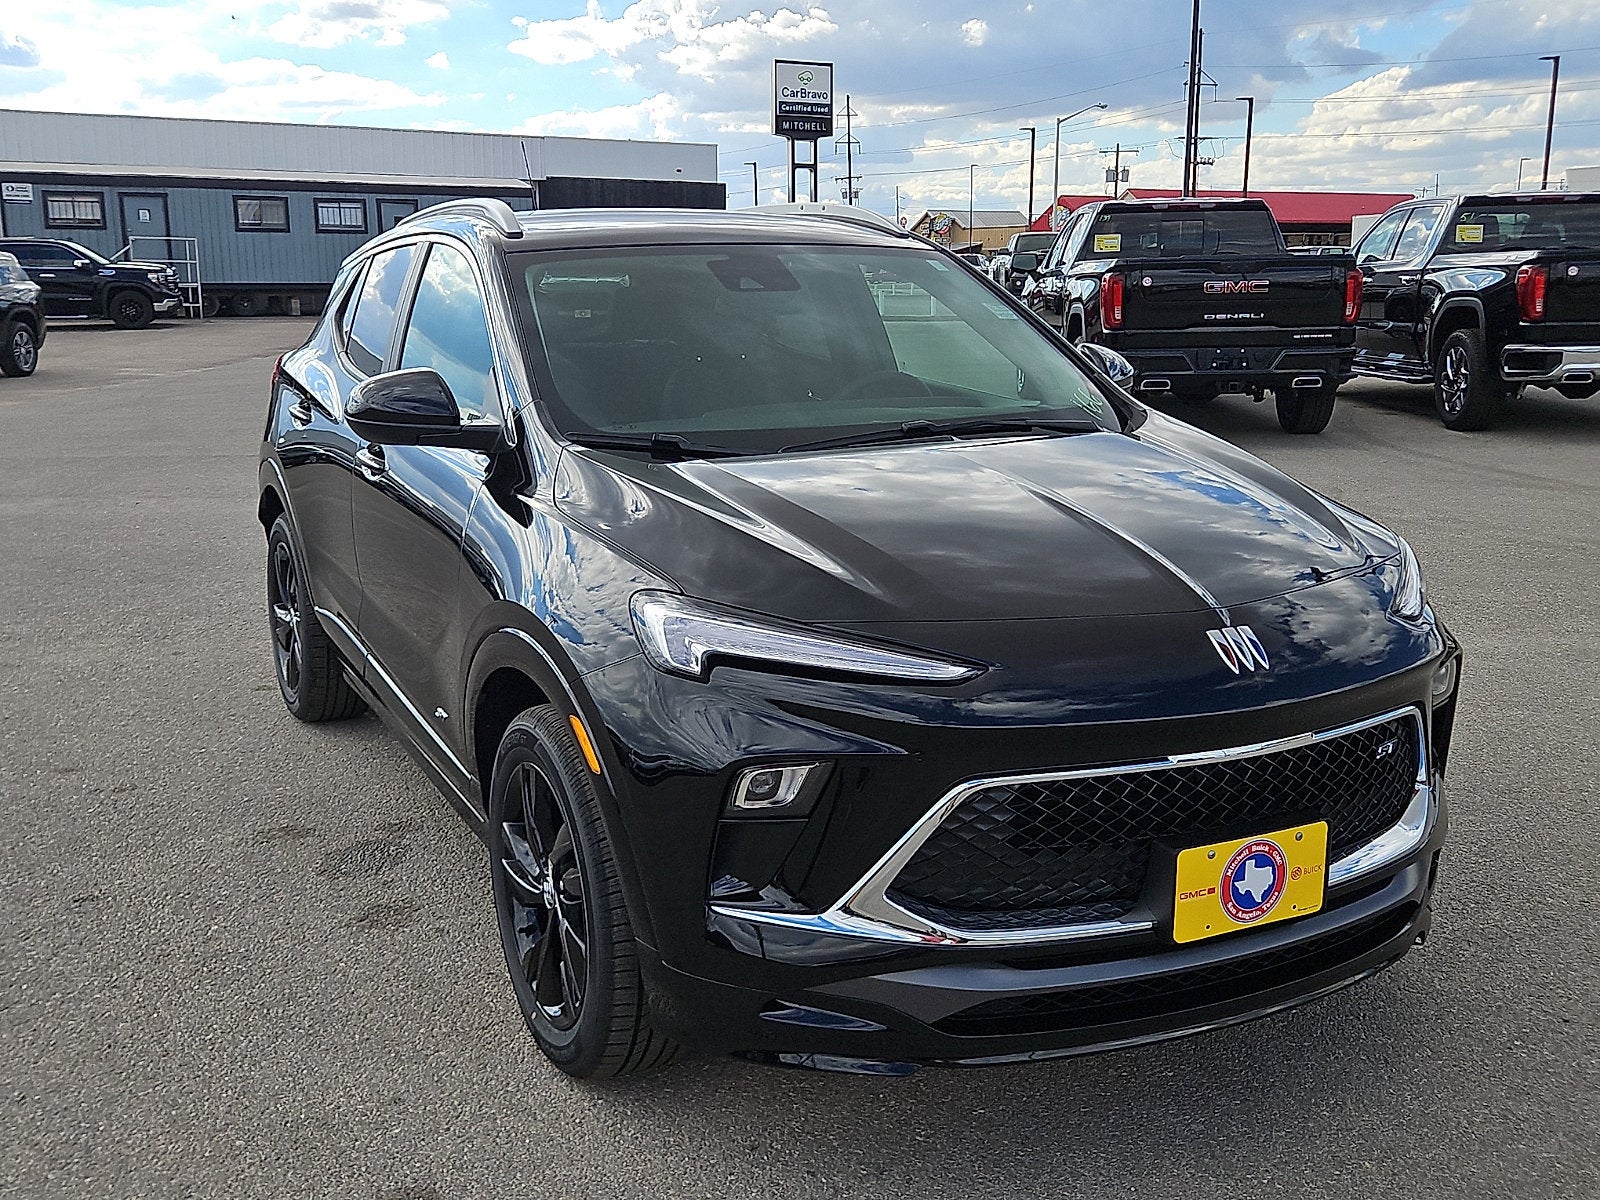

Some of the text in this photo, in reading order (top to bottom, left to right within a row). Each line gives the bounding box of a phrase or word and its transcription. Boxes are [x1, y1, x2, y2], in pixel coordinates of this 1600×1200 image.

[782, 87, 828, 99] CarBravo
[781, 104, 828, 113] Certified Used
[782, 121, 826, 131] MITCHELL
[1203, 280, 1270, 294] GMC
[1226, 844, 1283, 877] Mitchell Buick GMC
[1303, 864, 1322, 875] BUICK
[1179, 889, 1207, 900] GMC
[1226, 891, 1279, 919] San Angelo, Texas
